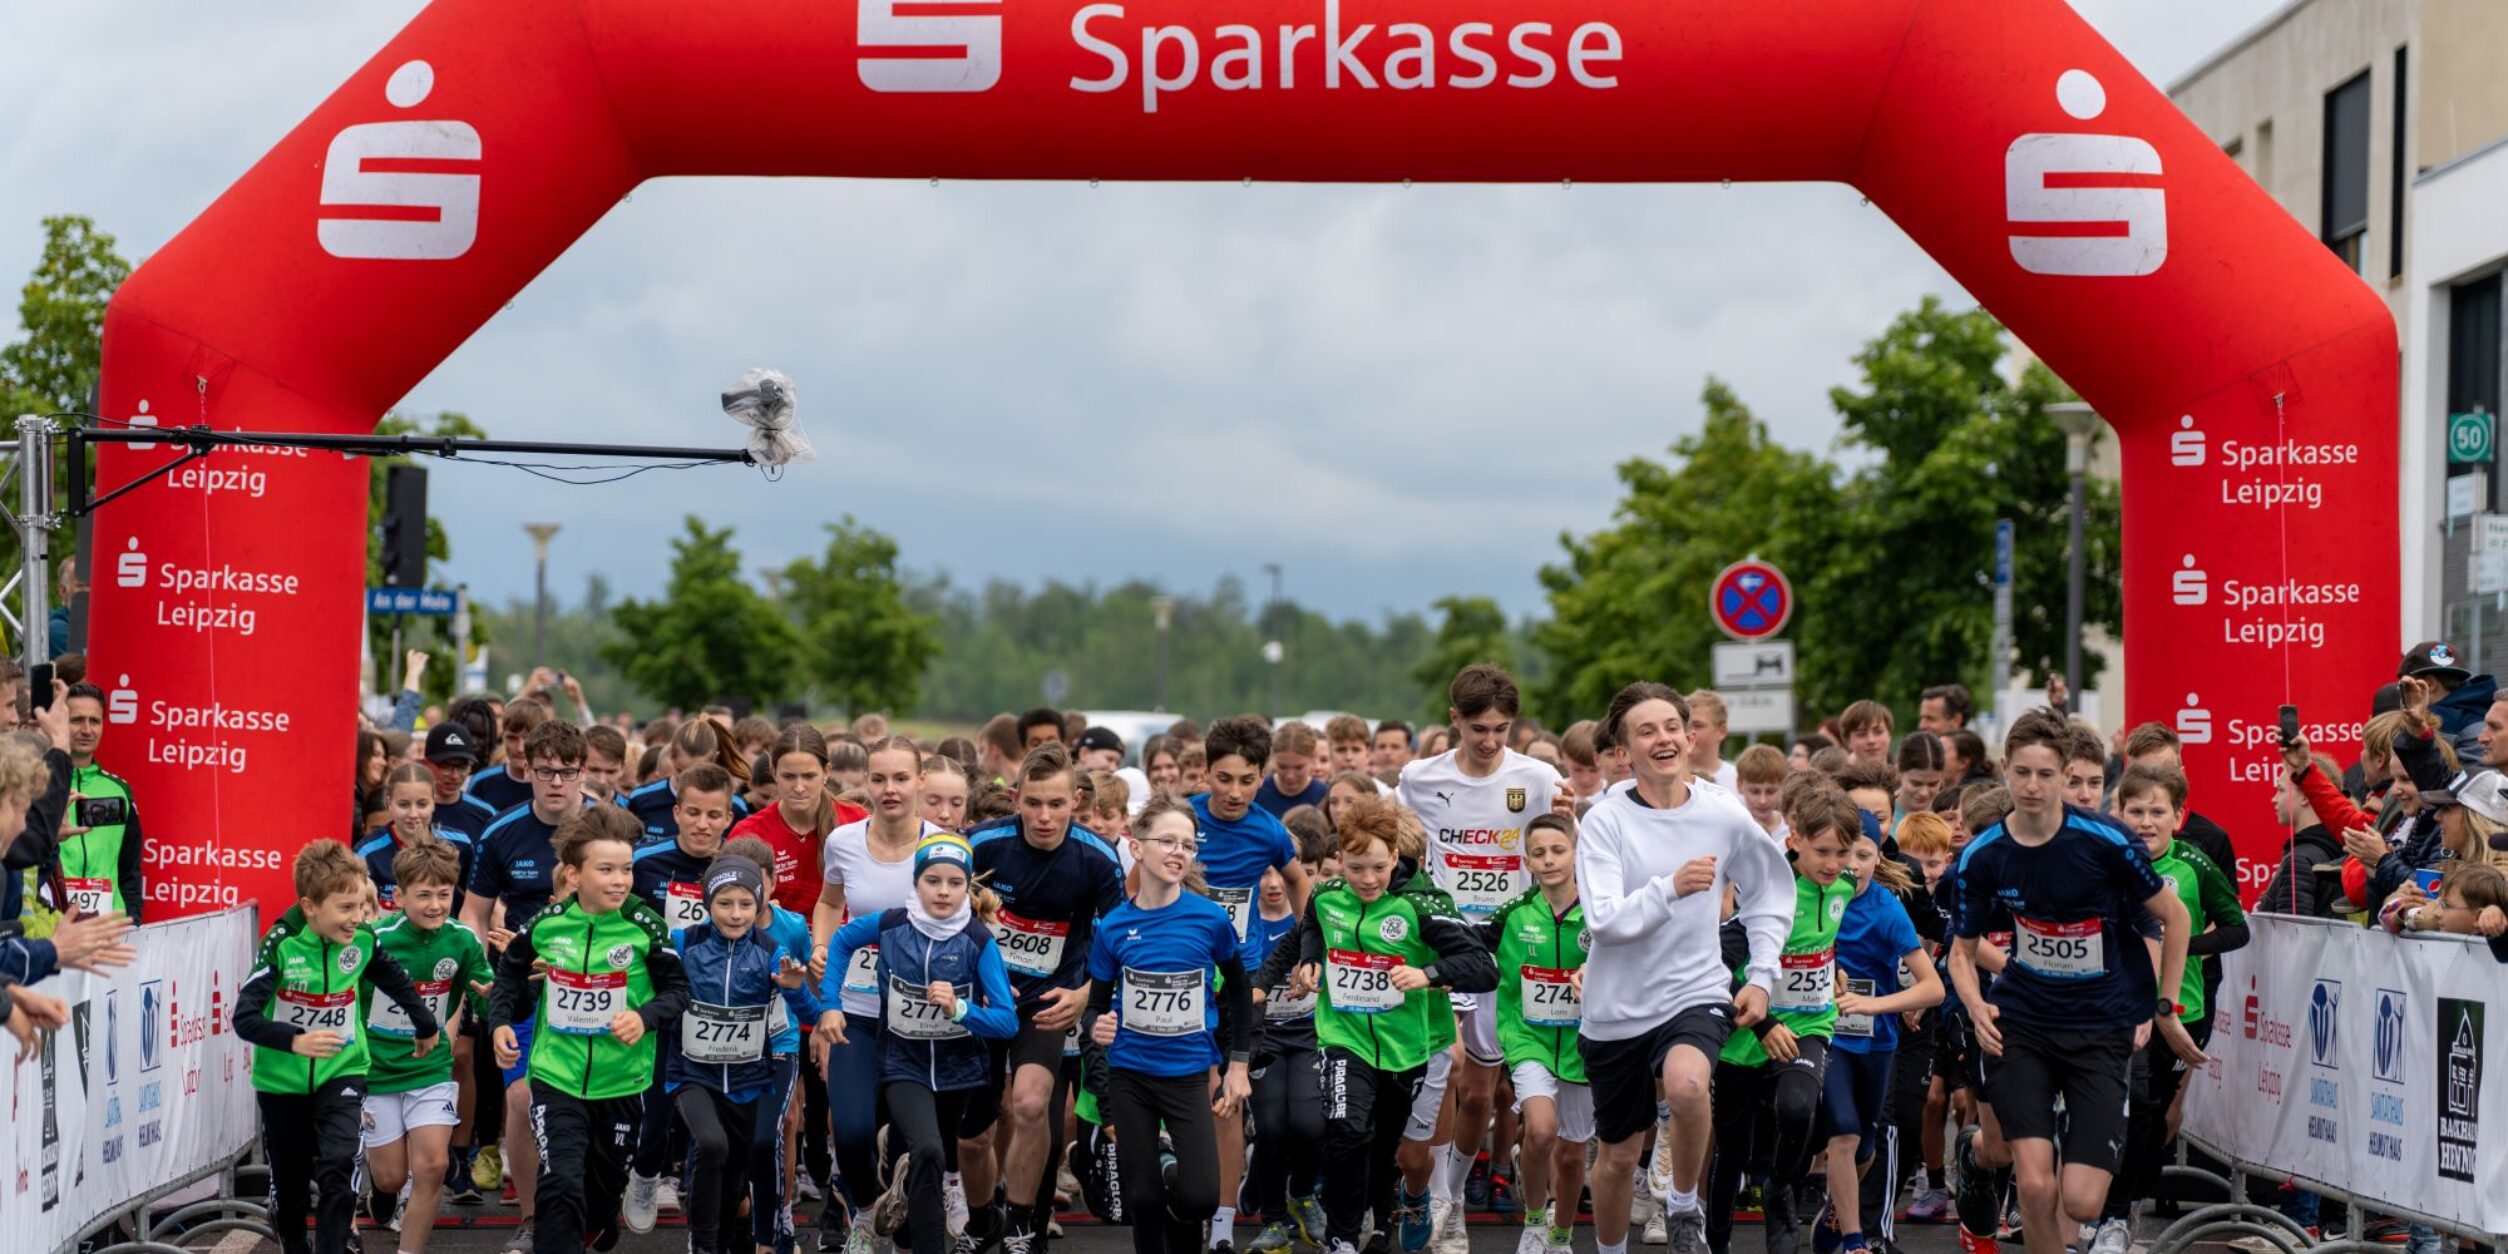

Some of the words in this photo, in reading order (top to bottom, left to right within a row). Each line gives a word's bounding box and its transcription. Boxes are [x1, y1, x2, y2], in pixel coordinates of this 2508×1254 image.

[1070, 0, 1622, 113] Sparkasse
[170, 428, 308, 457] Sarkasse
[2457, 426, 2481, 449] 50
[2222, 439, 2358, 472] Sparkasse
[168, 466, 266, 497] Leipzig
[2222, 477, 2323, 510] Leipzig
[160, 562, 299, 594] Sparkasse
[2223, 578, 2360, 611] Sparkasse
[157, 601, 256, 634] Leipzig
[2224, 616, 2325, 649] Leipzig
[150, 700, 290, 732] Sparkasse
[2227, 718, 2363, 750] Spakasse
[148, 737, 247, 773] Leipzig
[2229, 756, 2286, 788] Leip
[1439, 826, 1521, 851] CHECK24
[143, 837, 282, 869] Sparkasse
[515, 859, 535, 867] JAKO
[141, 876, 239, 909] Leipzig
[1457, 871, 1509, 892] 2526
[678, 900, 704, 921] 26
[996, 928, 1052, 955] 2608
[2027, 933, 2088, 959] 2505
[860, 949, 880, 971] 27
[1337, 967, 1389, 991] 2738
[557, 988, 611, 1012] 2739
[1135, 990, 1191, 1012] 2776
[1534, 983, 1581, 1004] 274
[290, 1006, 346, 1027] 2748
[901, 999, 951, 1020] 277
[695, 1020, 751, 1043] 2774
